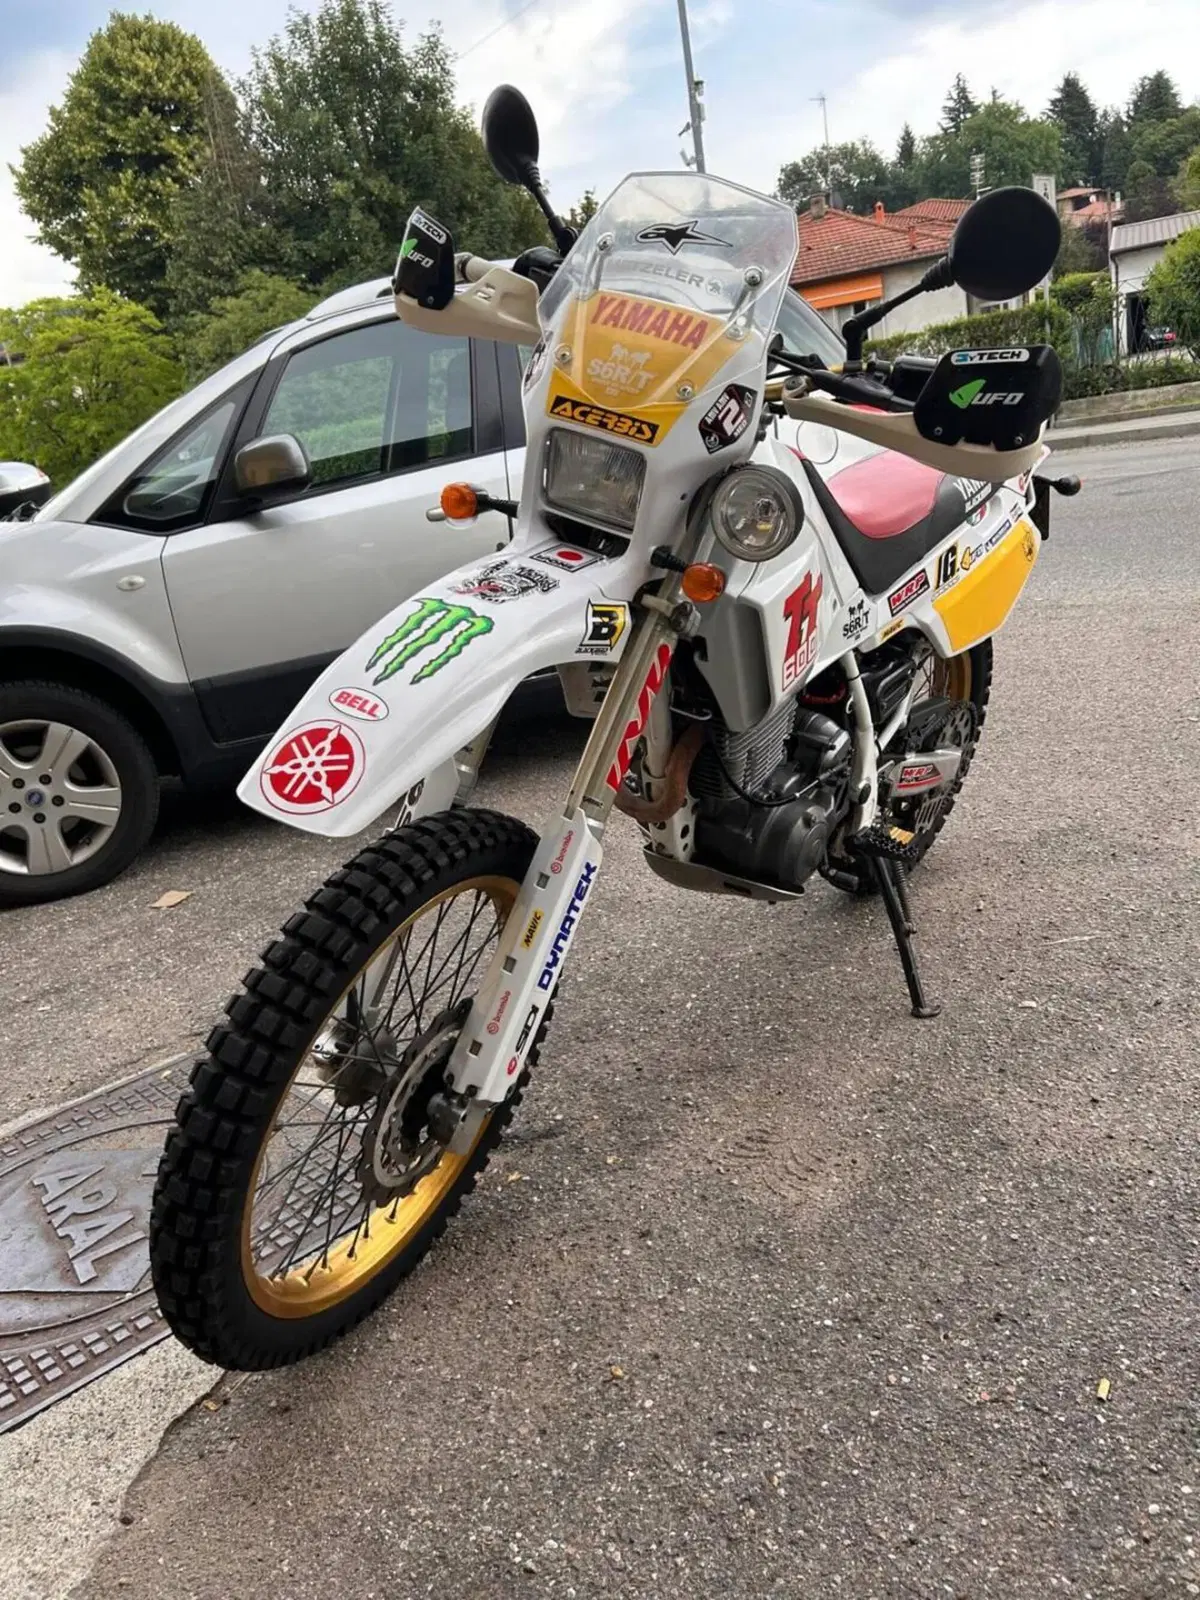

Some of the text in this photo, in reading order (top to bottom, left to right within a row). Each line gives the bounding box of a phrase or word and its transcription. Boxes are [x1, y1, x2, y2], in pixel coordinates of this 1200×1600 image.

[408, 249, 434, 268] UFO
[591, 295, 708, 350] YAMAHA
[718, 399, 745, 436] 2
[971, 393, 1025, 405] UFO
[889, 572, 925, 609] WRP
[334, 690, 380, 718] BELL
[555, 829, 574, 863] brembo
[524, 910, 543, 947] MAVIC
[537, 861, 598, 991] DYNATEK
[493, 989, 511, 1023] brembo
[31, 1164, 147, 1286] ARAL
